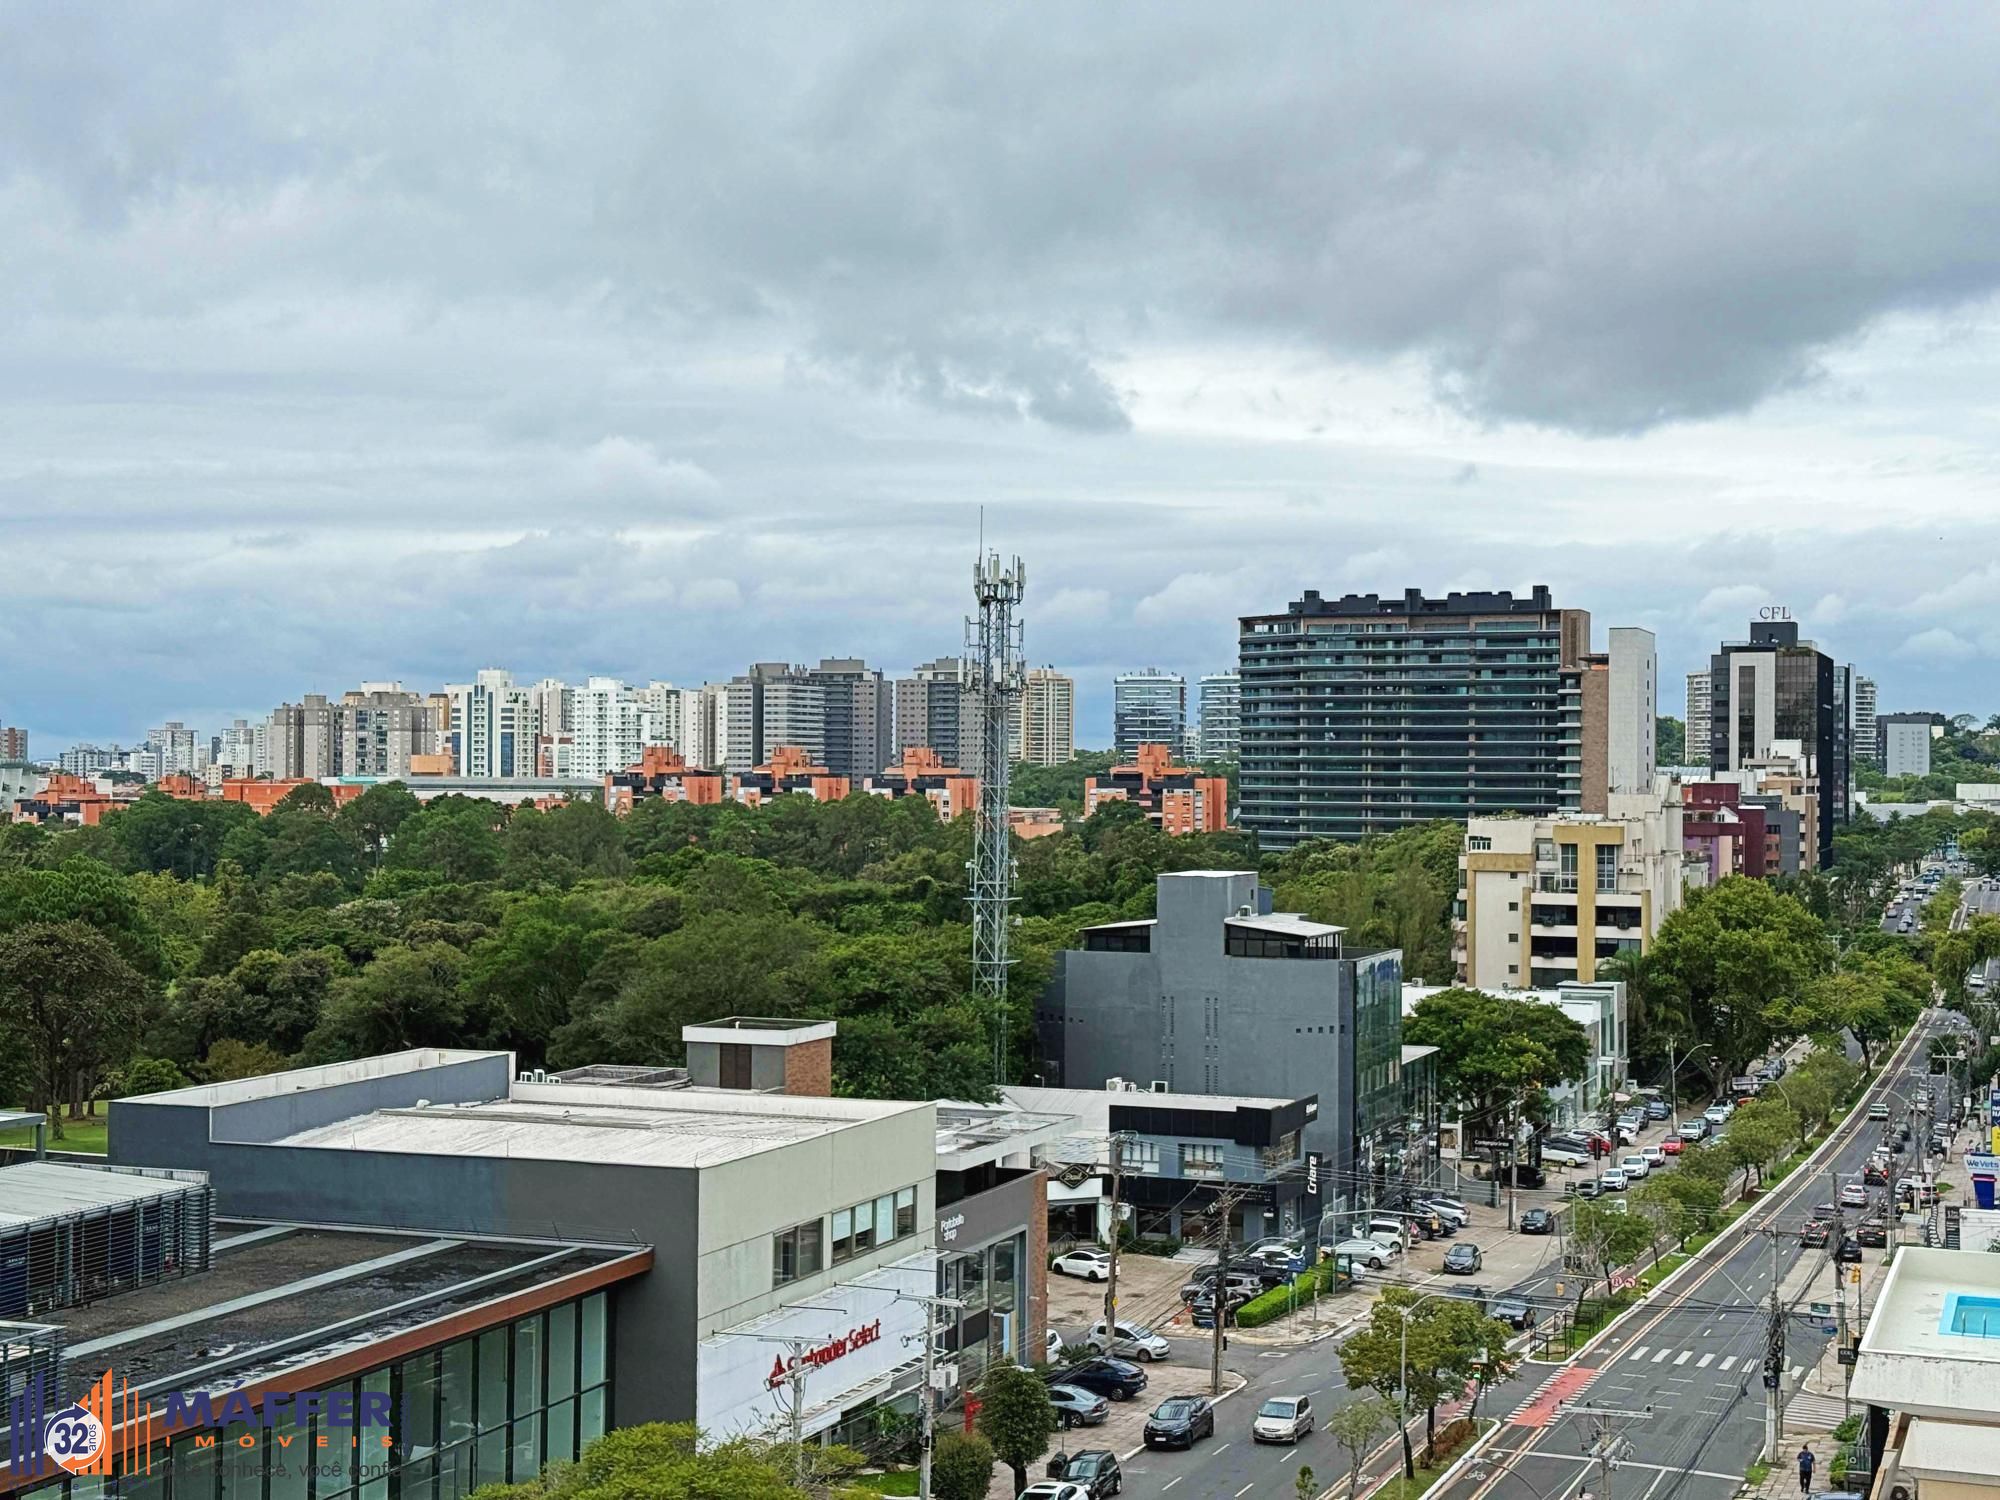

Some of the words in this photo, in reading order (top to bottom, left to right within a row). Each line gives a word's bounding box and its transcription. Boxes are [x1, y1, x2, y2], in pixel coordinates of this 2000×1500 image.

[1760, 606, 1791, 620] CFL
[1307, 1155, 1317, 1195] Criare
[1967, 1159, 1979, 1167] We
[1980, 1160, 1999, 1168] Vets
[848, 1318, 881, 1353] Select
